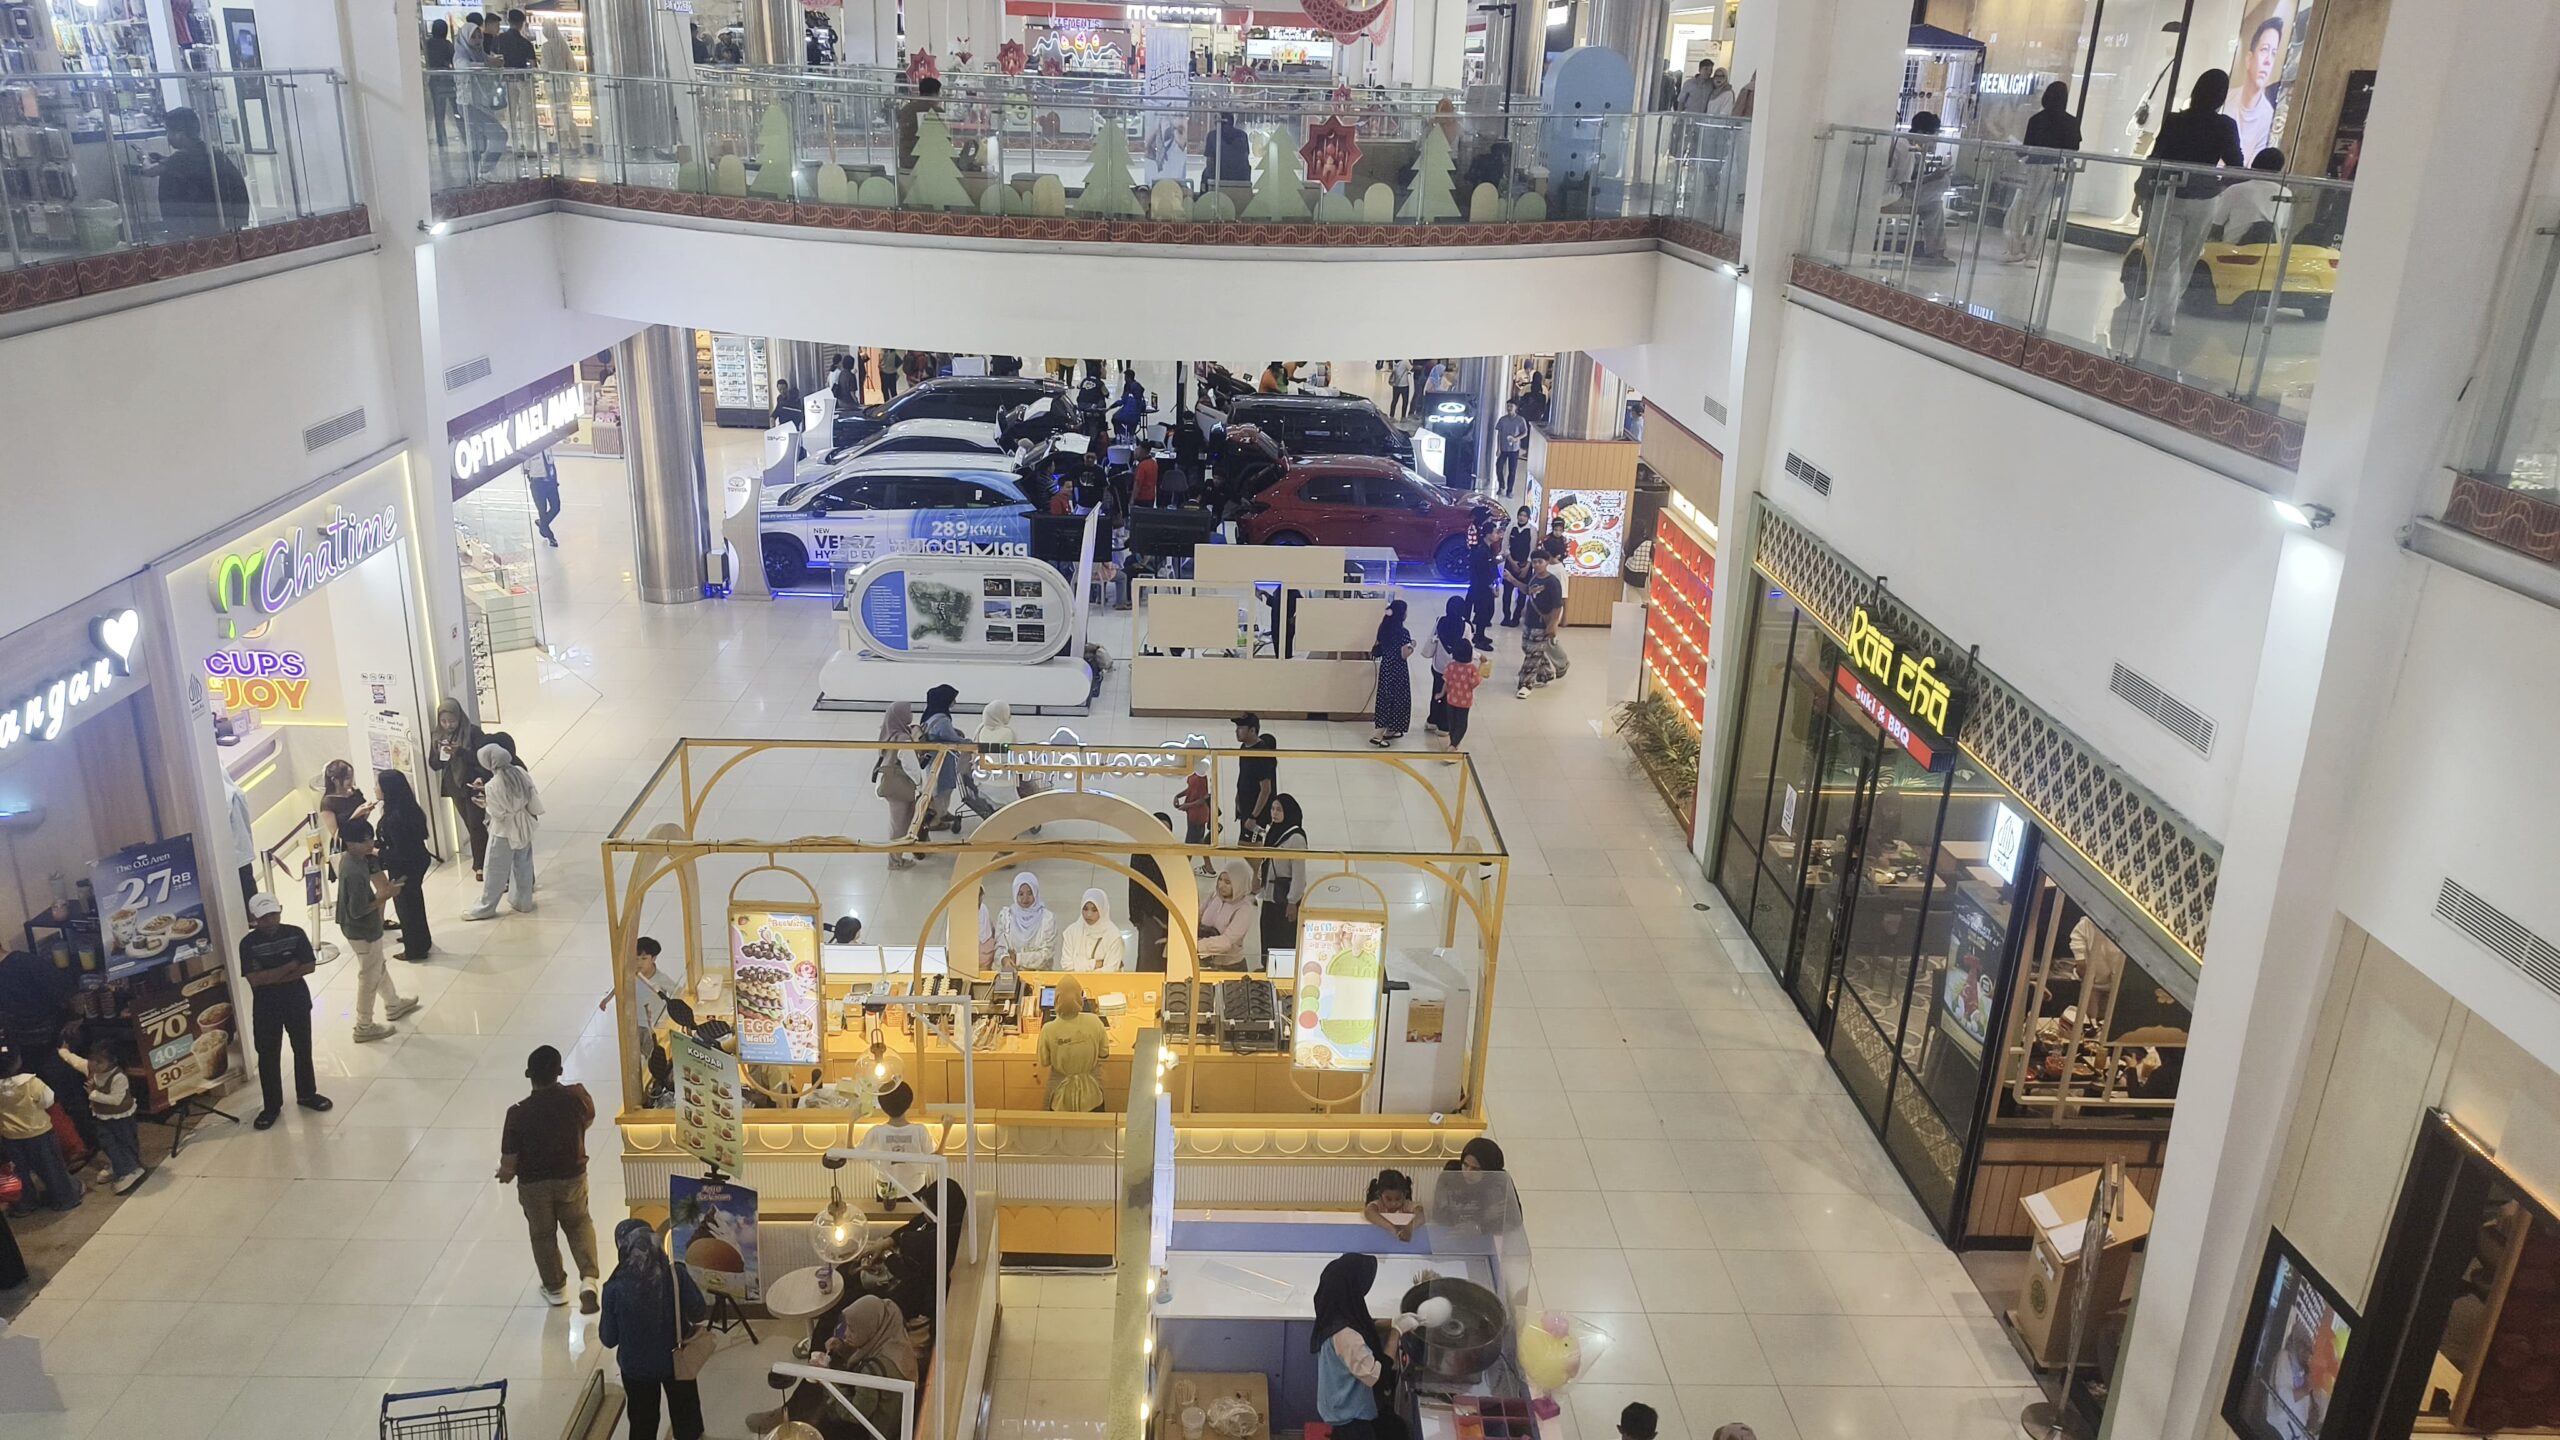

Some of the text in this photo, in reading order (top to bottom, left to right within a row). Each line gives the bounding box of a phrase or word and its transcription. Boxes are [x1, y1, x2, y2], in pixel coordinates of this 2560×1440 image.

[1980, 73, 2033, 95] REENLIGHT
[455, 382, 585, 479] OPTIK MELAWAI
[1428, 415, 1474, 424] CHERY
[260, 505, 398, 613] Chatime
[862, 550, 876, 559] EV
[203, 650, 305, 678] CUPS
[1847, 606, 1951, 736] Raa cha
[224, 677, 310, 711] JOY
[1855, 683, 1911, 749] Suki & BBQ
[115, 864, 132, 873] The
[149, 852, 171, 864] Aren
[118, 868, 172, 910] 27
[172, 872, 191, 885] RB
[744, 1020, 774, 1033] EGG
[154, 1045, 177, 1063] 40
[160, 1067, 182, 1086] 30
